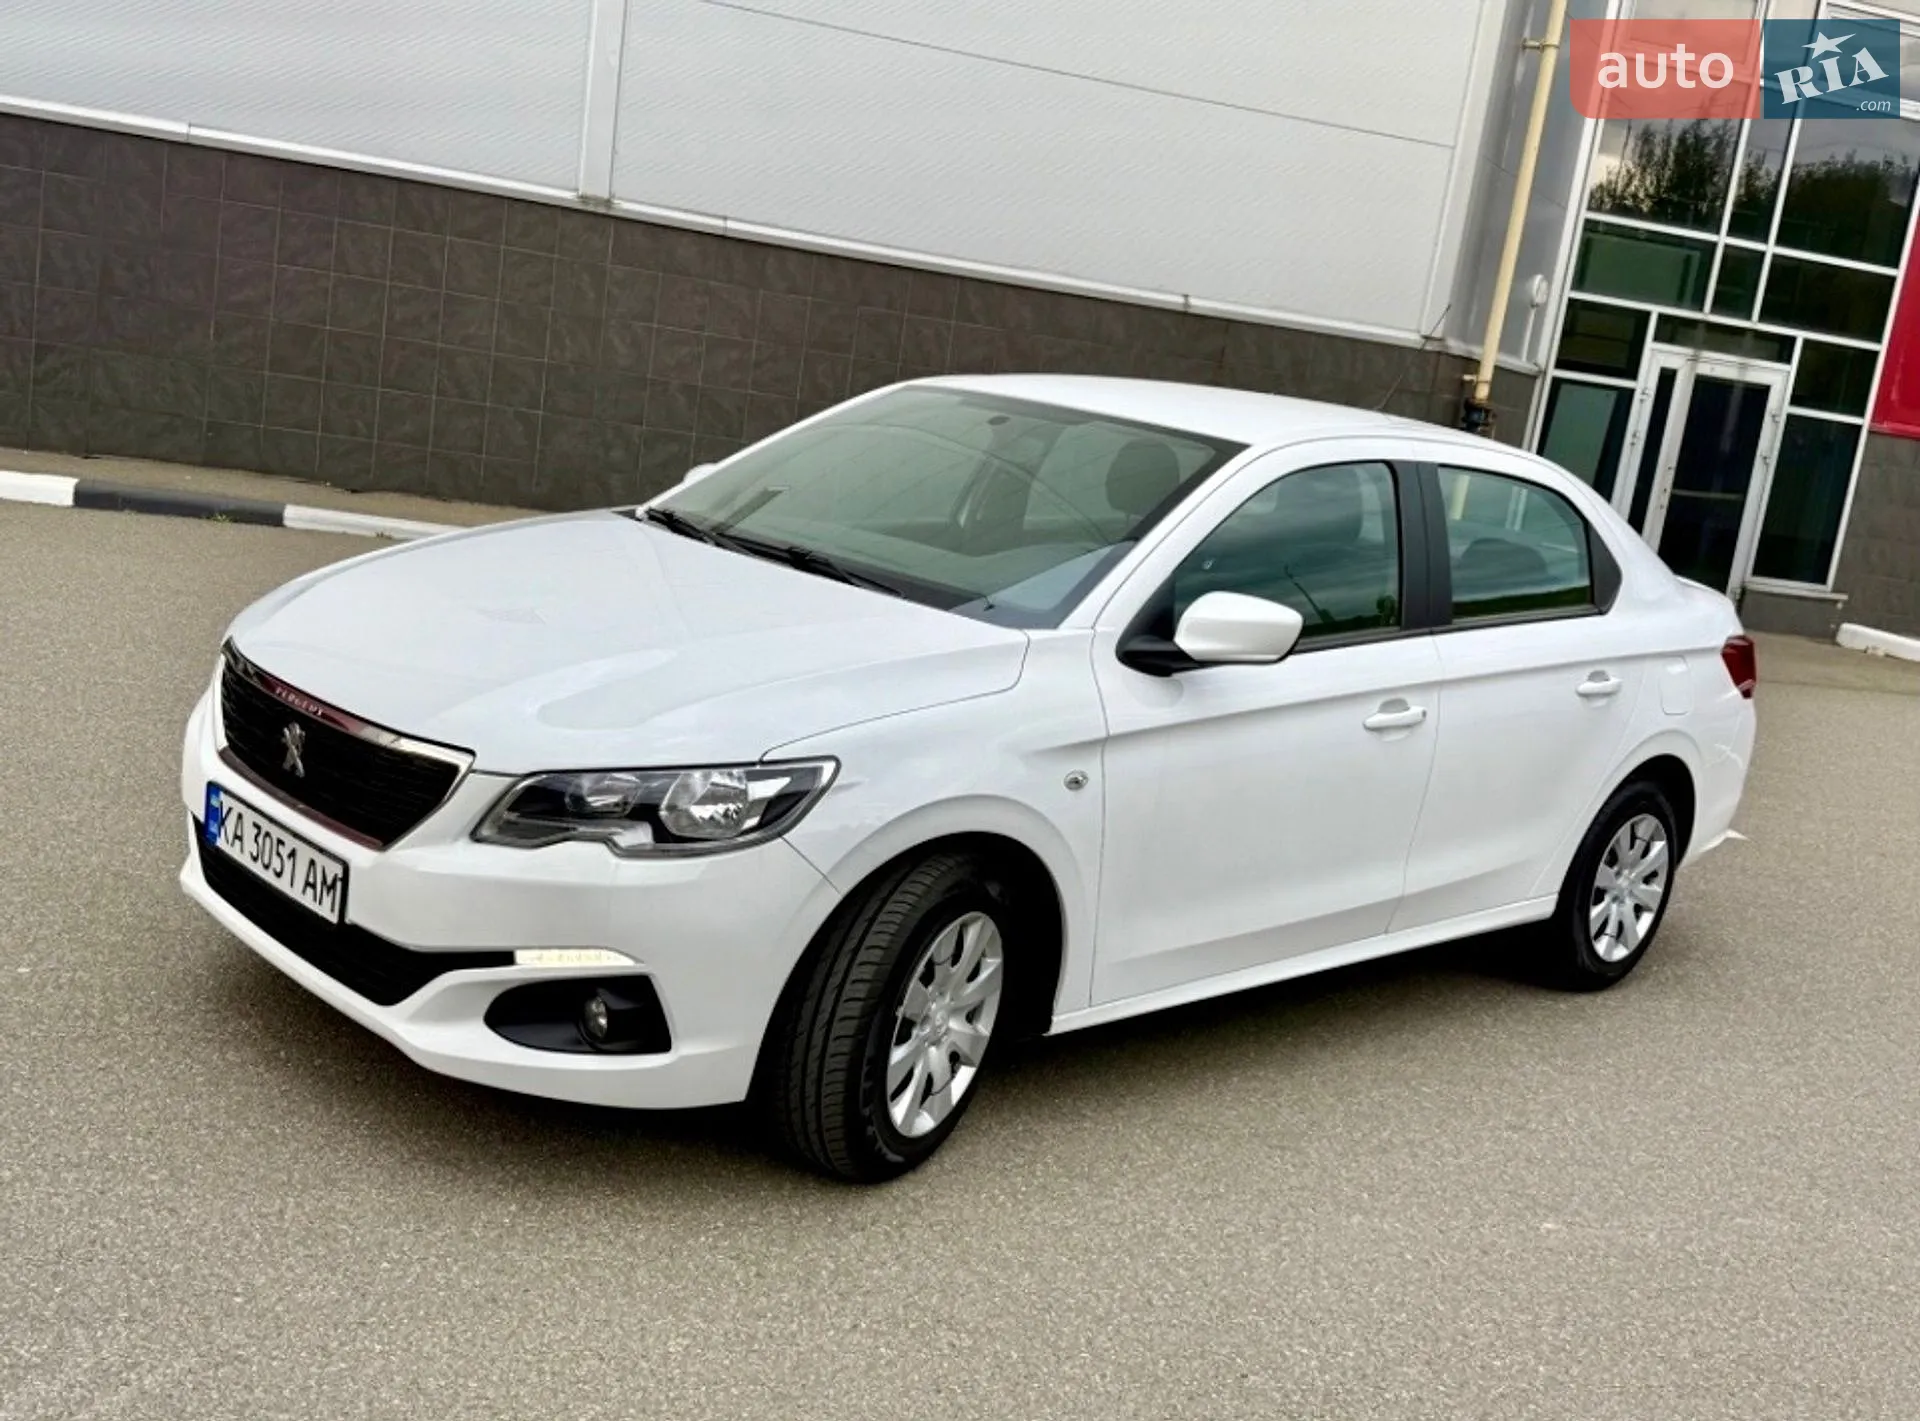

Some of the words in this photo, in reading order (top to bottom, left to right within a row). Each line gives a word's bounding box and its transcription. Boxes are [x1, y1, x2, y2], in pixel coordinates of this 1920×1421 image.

[218, 800, 244, 854] KA
[249, 821, 297, 888] 3051
[302, 857, 338, 913] AM
